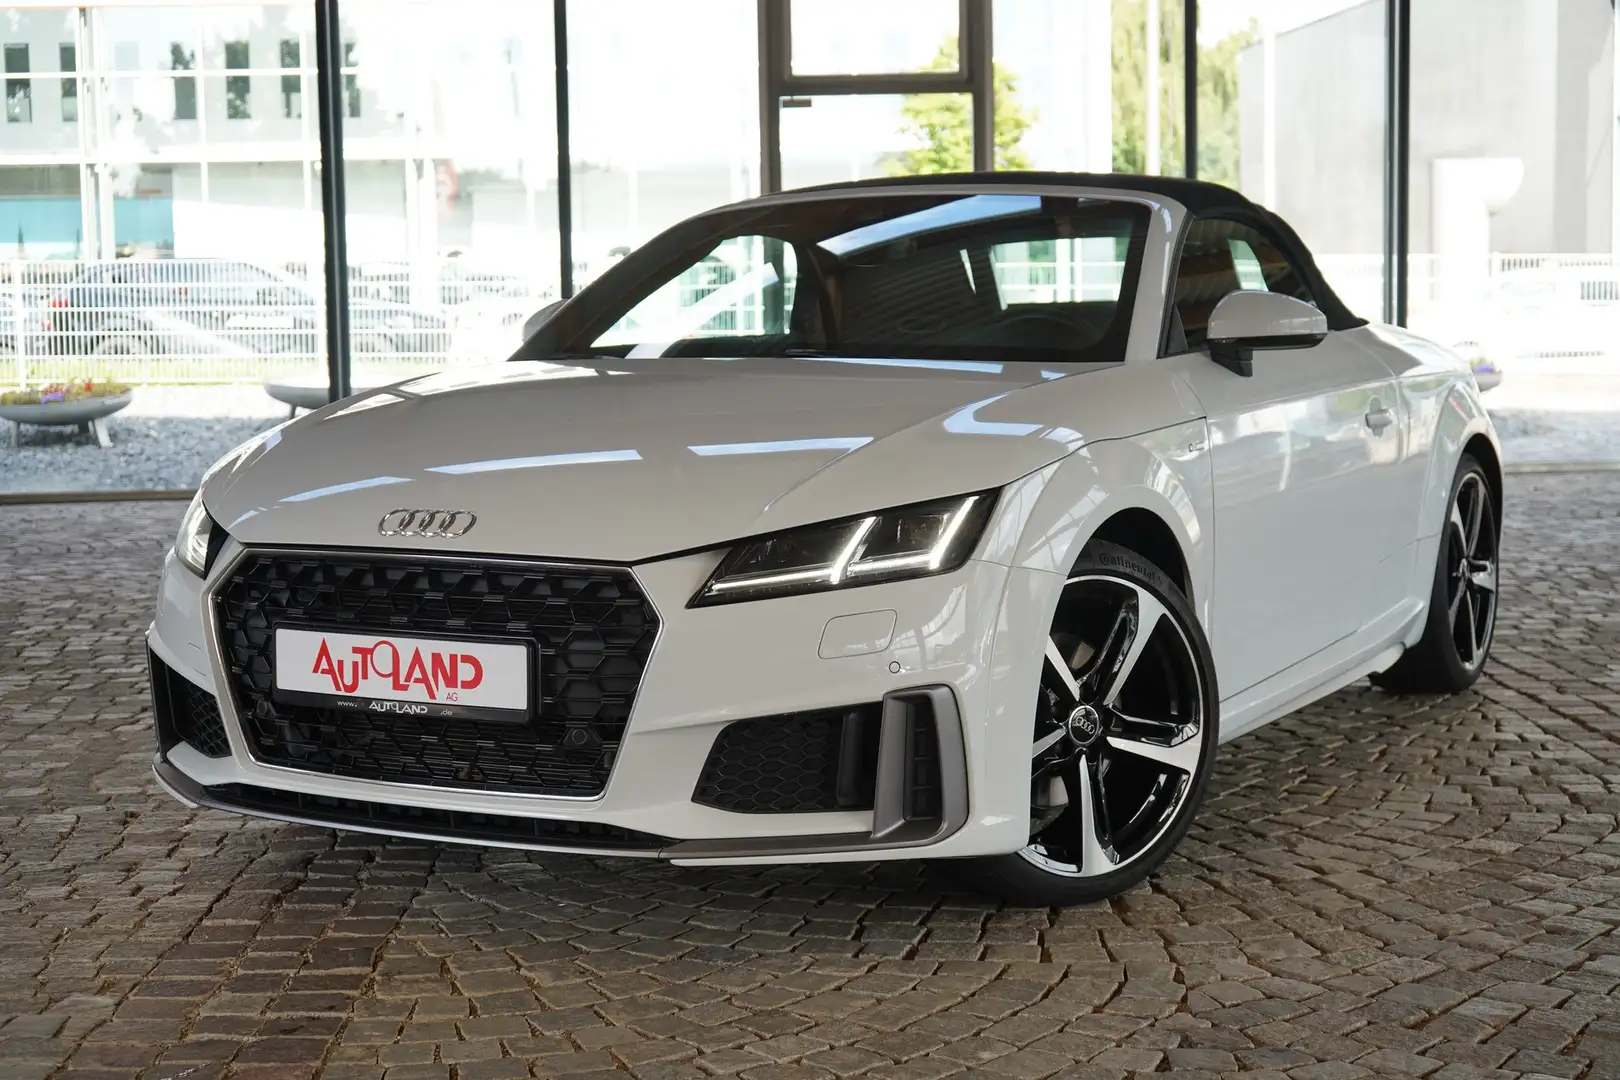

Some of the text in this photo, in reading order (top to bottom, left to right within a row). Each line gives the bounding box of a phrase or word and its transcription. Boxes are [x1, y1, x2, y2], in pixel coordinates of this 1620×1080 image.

[1099, 552, 1156, 582] Continental
[312, 637, 484, 701] AUTOLAND
[368, 700, 428, 715] AUTOLAND
[445, 691, 459, 702] AG
